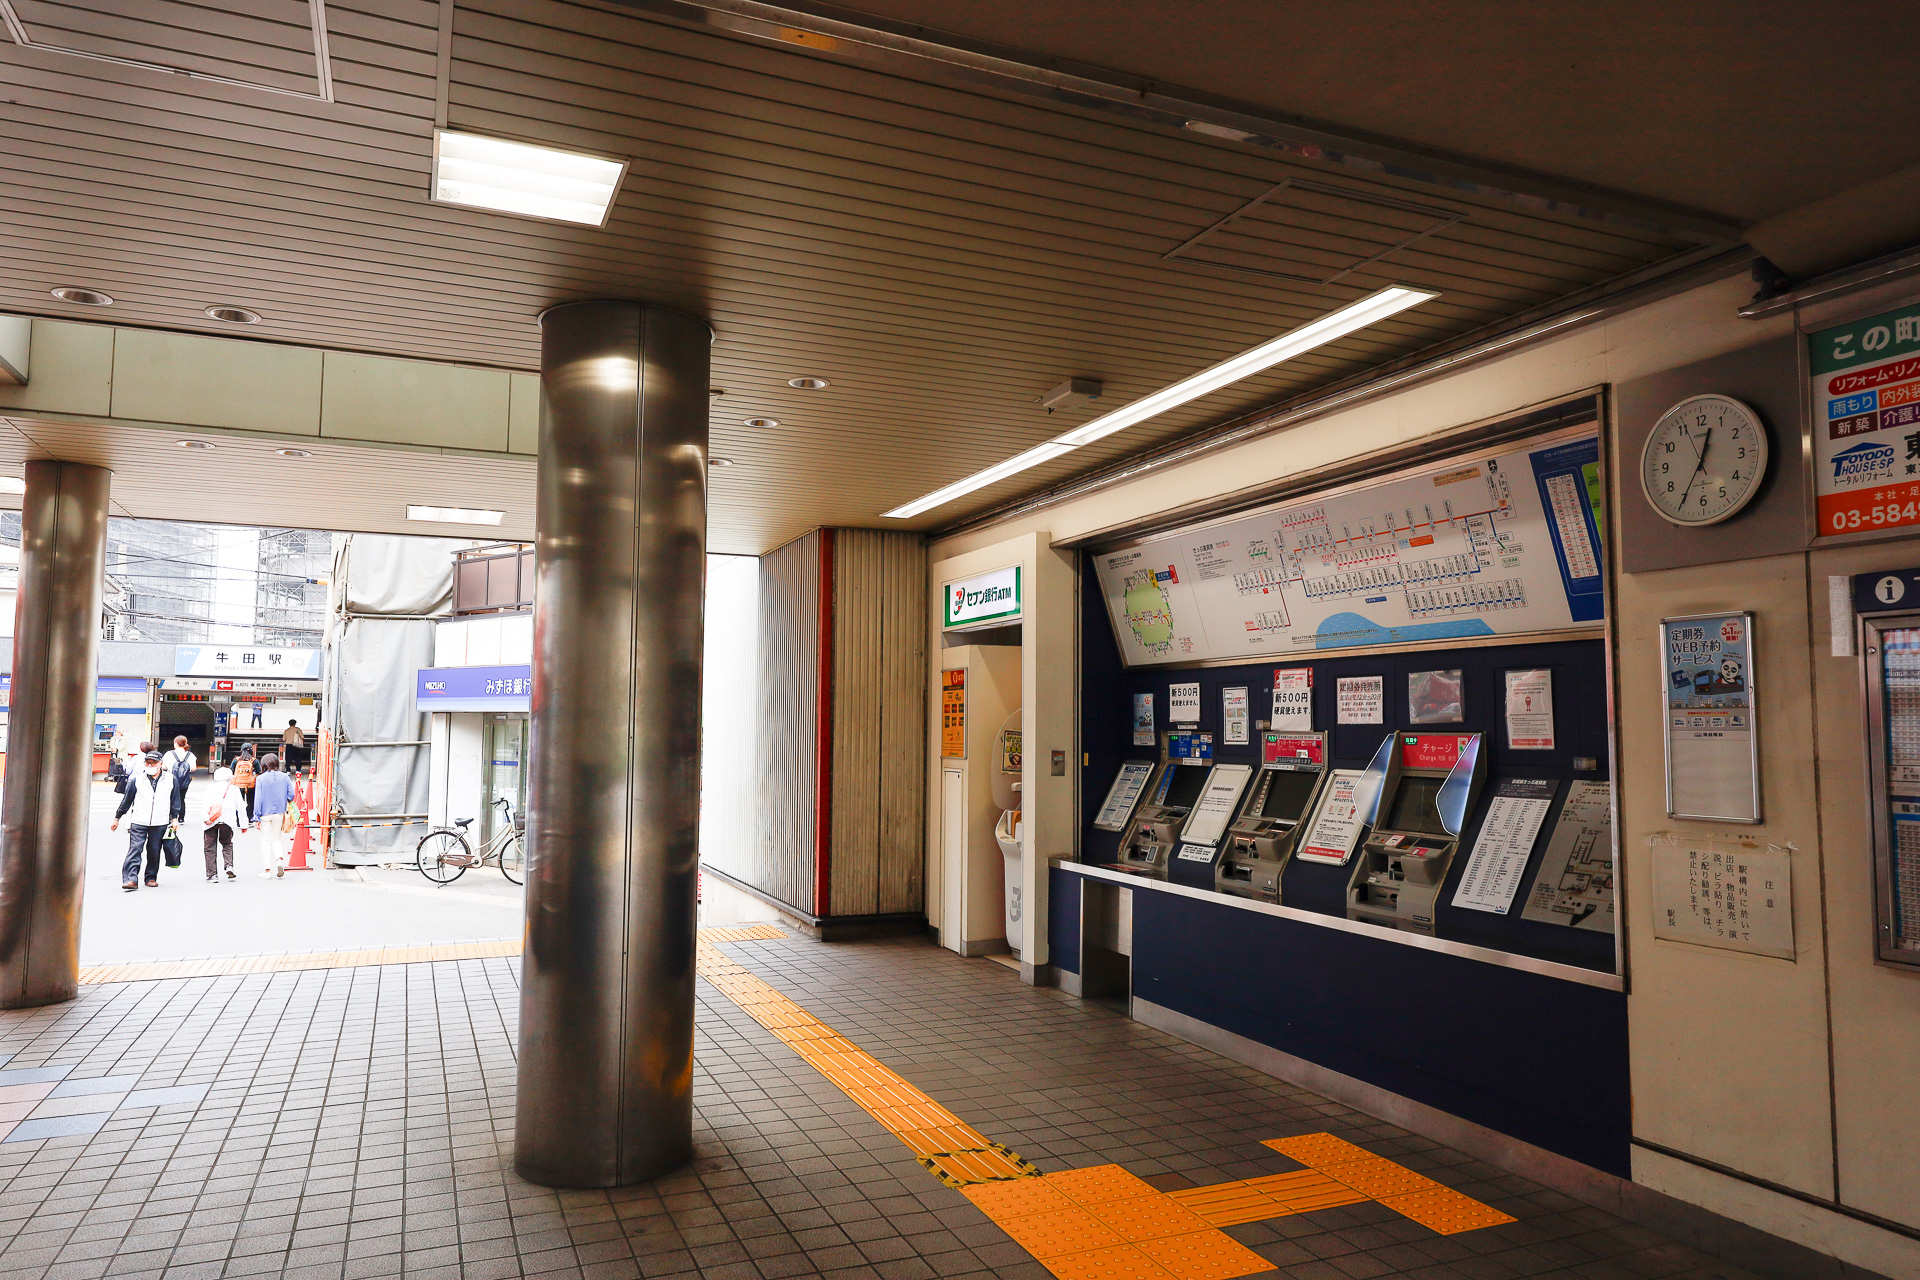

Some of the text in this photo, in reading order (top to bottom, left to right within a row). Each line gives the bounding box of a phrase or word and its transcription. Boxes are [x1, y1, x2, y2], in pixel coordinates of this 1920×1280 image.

[1836, 362, 1920, 391] リフォーム・リノ
[1833, 396, 1872, 415] 雨もり
[1696, 415, 1707, 426] 12
[1718, 416, 1723, 427] 1
[1837, 417, 1870, 435] 新築
[1678, 424, 1688, 436] 11
[1732, 428, 1739, 439] 2
[1665, 442, 1675, 453] 10
[1738, 448, 1745, 459] 3
[1662, 463, 1669, 473] 9
[1830, 448, 1894, 478] TOYODO
[1732, 470, 1740, 480] 4
[1834, 469, 1893, 487] トータルリフォーム
[1667, 481, 1675, 492] 8
[1719, 486, 1726, 498] 5
[1700, 495, 1707, 506] 6
[1833, 502, 1920, 530] 03-584
[967, 586, 1012, 607] セブン銀行ATM
[1671, 627, 1704, 641] 定期券
[1671, 640, 1721, 653] WEB予約
[216, 652, 282, 665] 牛田駅
[1672, 653, 1714, 667] サービス
[424, 681, 446, 690] MIZUHO
[1340, 681, 1380, 691] 定期券発売所
[1172, 688, 1197, 697] 新500円
[1275, 693, 1308, 703] 新500円
[1423, 744, 1452, 753] チャージ
[1764, 879, 1775, 909] 注意
[1738, 864, 1750, 941] 駅構内に於いて
[1666, 908, 1676, 927] 駅長
